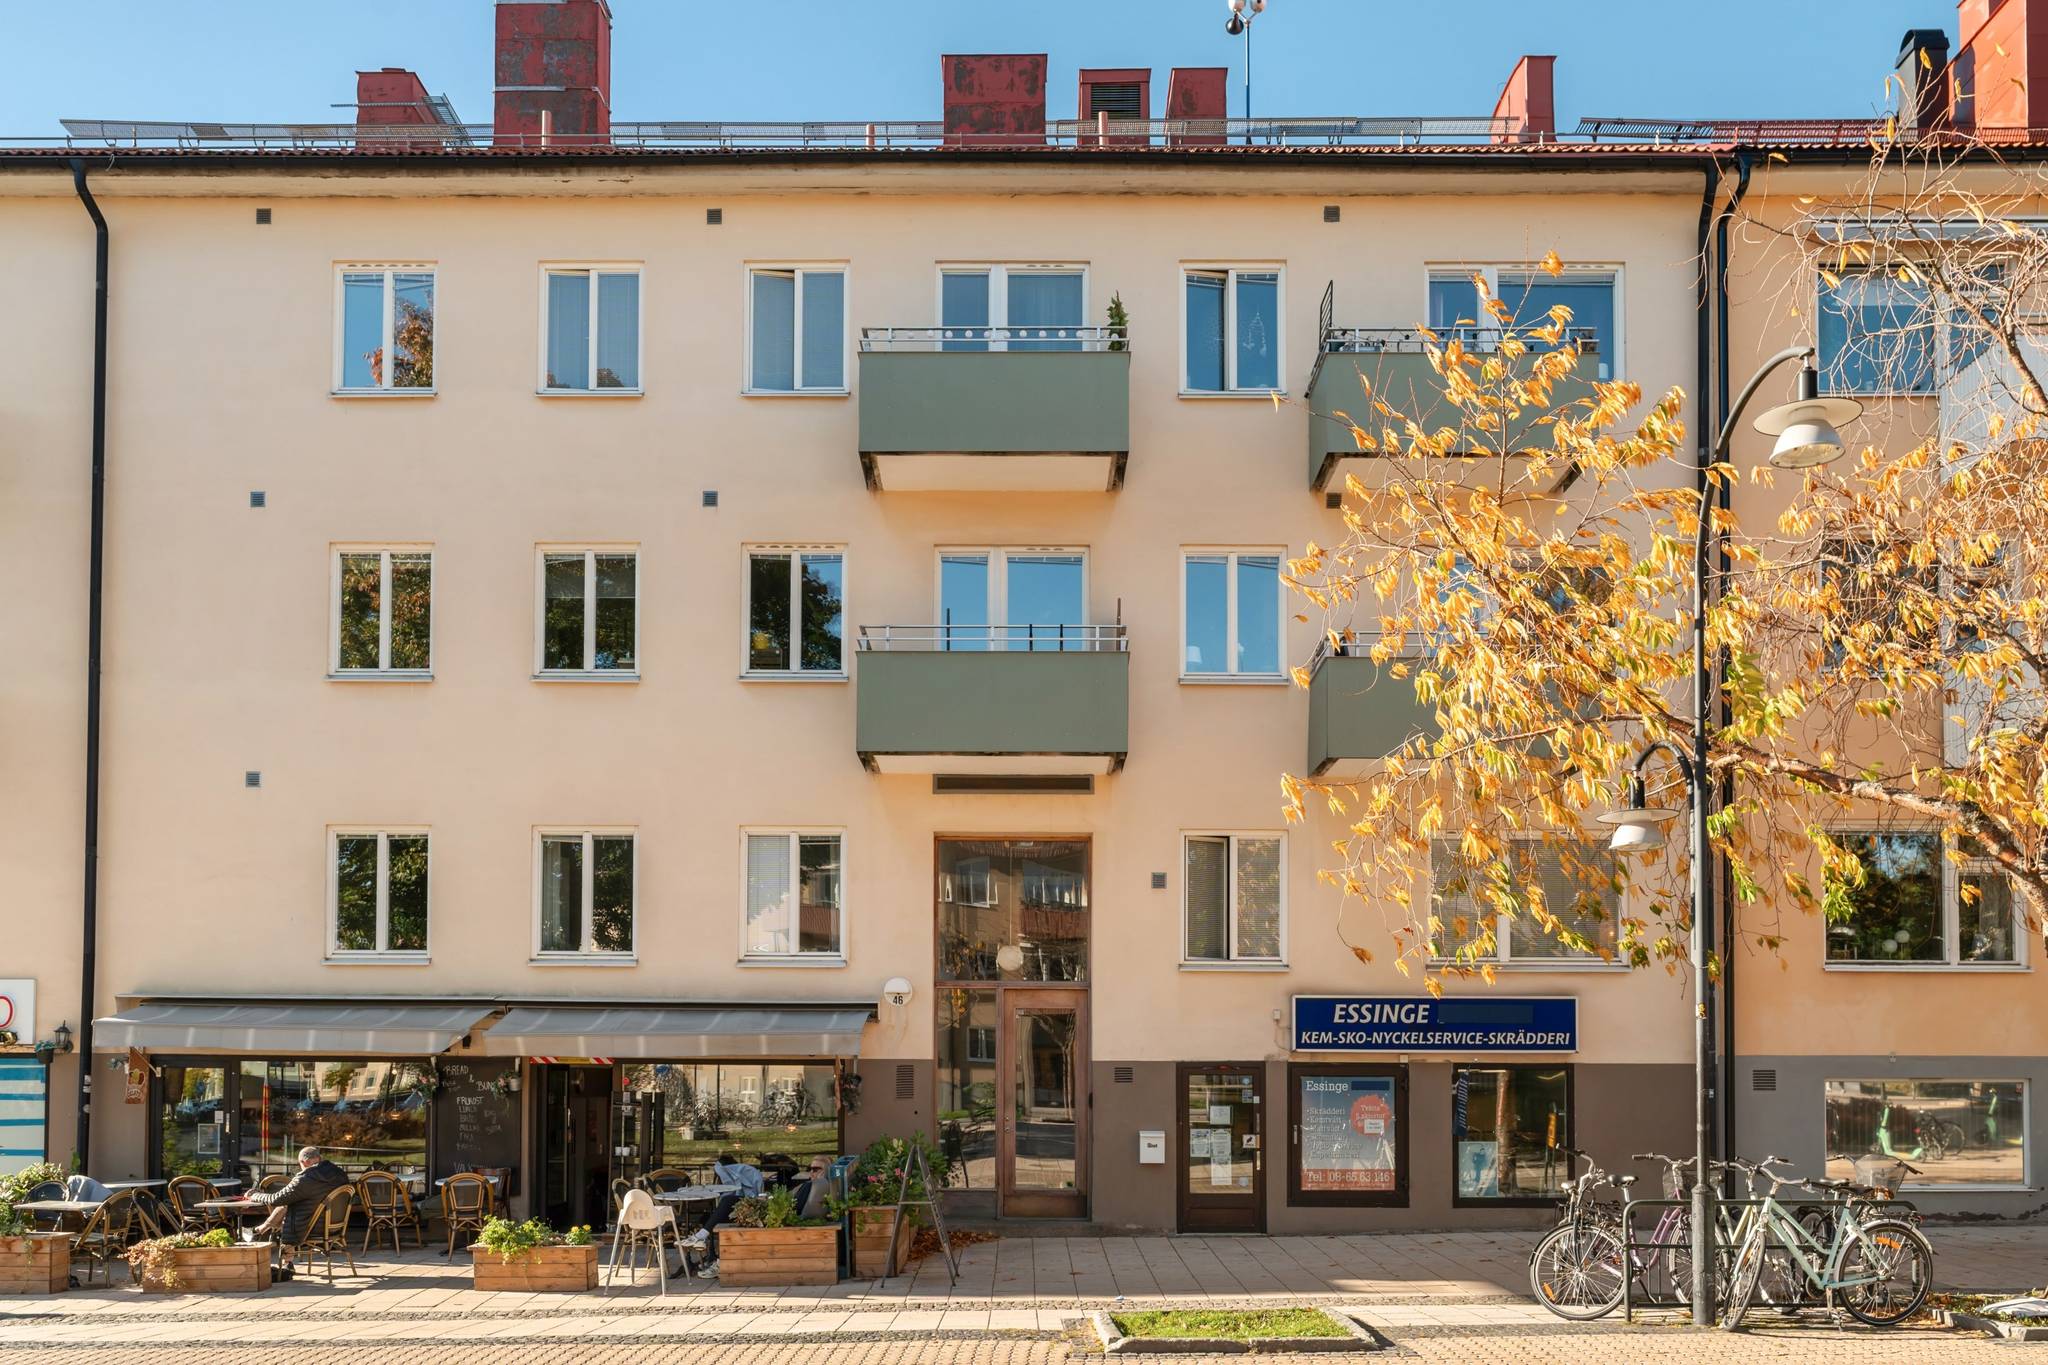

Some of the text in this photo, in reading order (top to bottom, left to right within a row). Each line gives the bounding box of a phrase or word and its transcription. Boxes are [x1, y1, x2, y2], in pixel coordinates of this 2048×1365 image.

[892, 995, 904, 1005] 46
[1333, 1004, 1430, 1024] ESSINGE
[1301, 1029, 1570, 1045] KEM-SKO-NYCKELSERVICE-SKRÄDDERI
[443, 1064, 469, 1075] BREAD
[1306, 1080, 1349, 1093] Essinge
[456, 1096, 484, 1105] FRUKOST
[1307, 1172, 1325, 1182] Tel:
